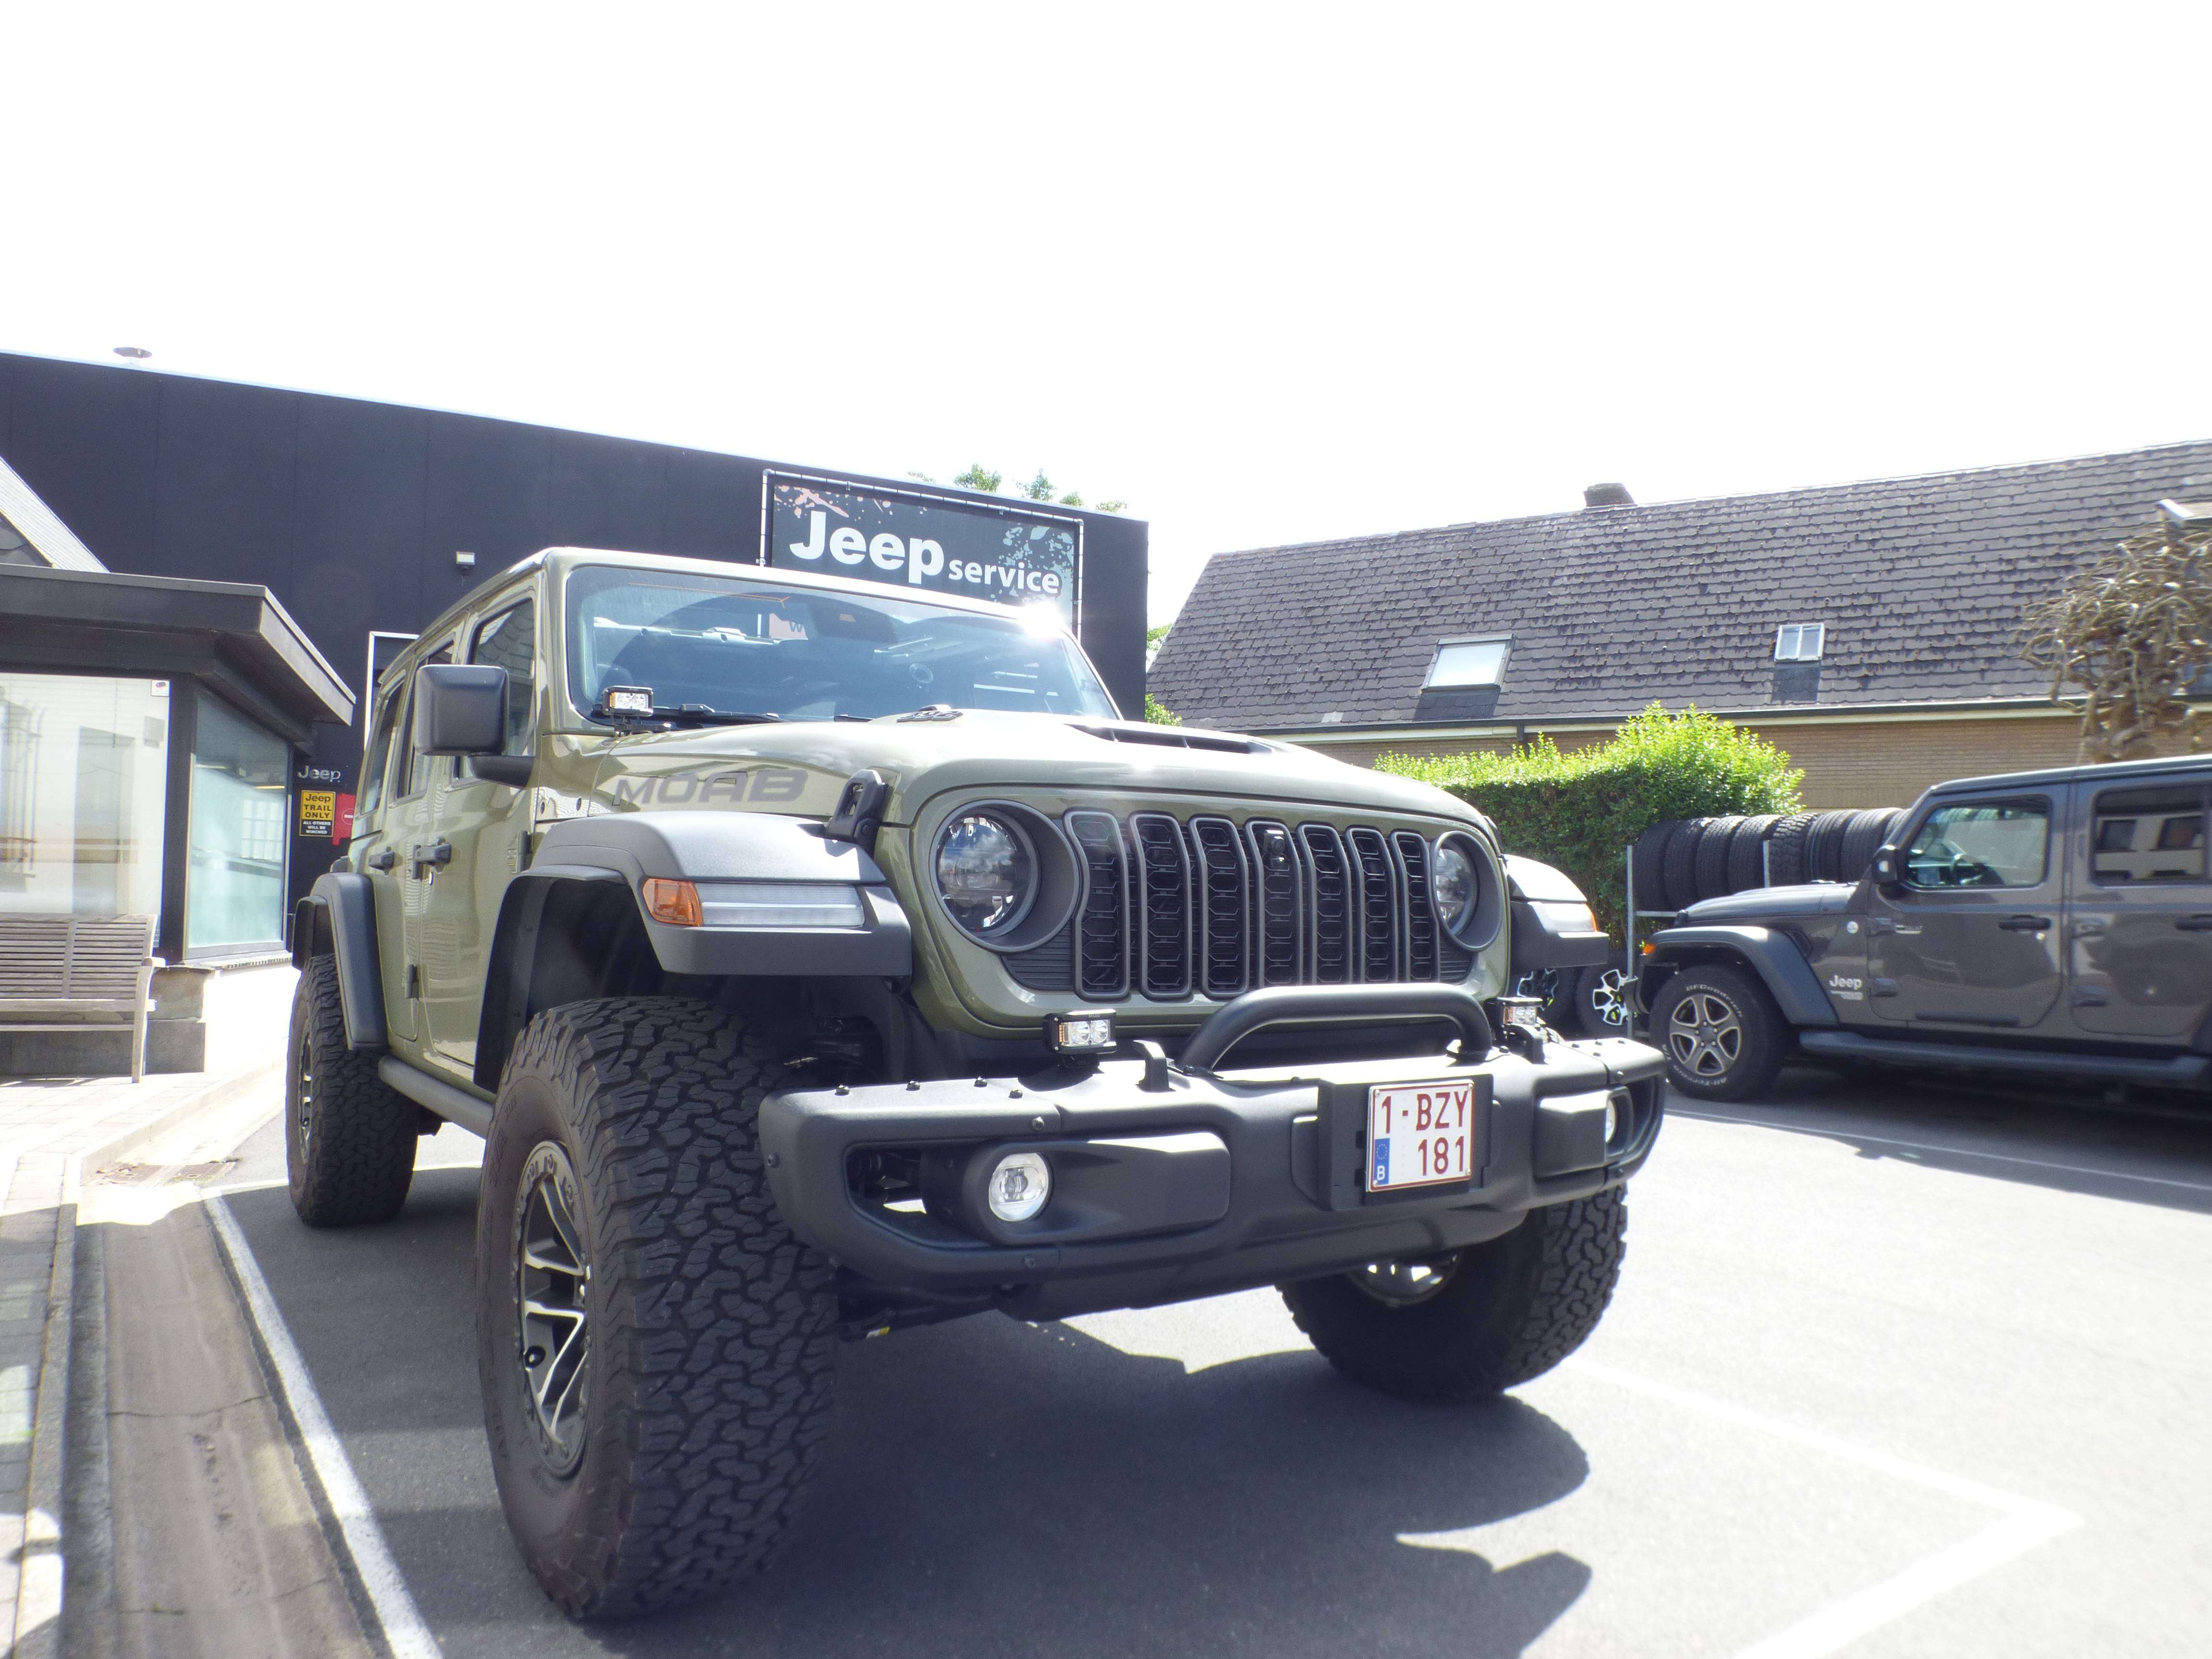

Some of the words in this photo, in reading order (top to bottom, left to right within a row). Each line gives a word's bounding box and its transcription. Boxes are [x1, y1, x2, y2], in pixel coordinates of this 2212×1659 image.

[790, 510, 945, 584] Jeep
[949, 559, 1060, 594] service
[297, 765, 341, 782] Jeep
[612, 769, 808, 806] MOAB
[305, 793, 331, 803] Jeep
[1829, 974, 1863, 990] Jeep
[1418, 1136, 1465, 1177] 181
[1377, 1165, 1386, 1181] B
